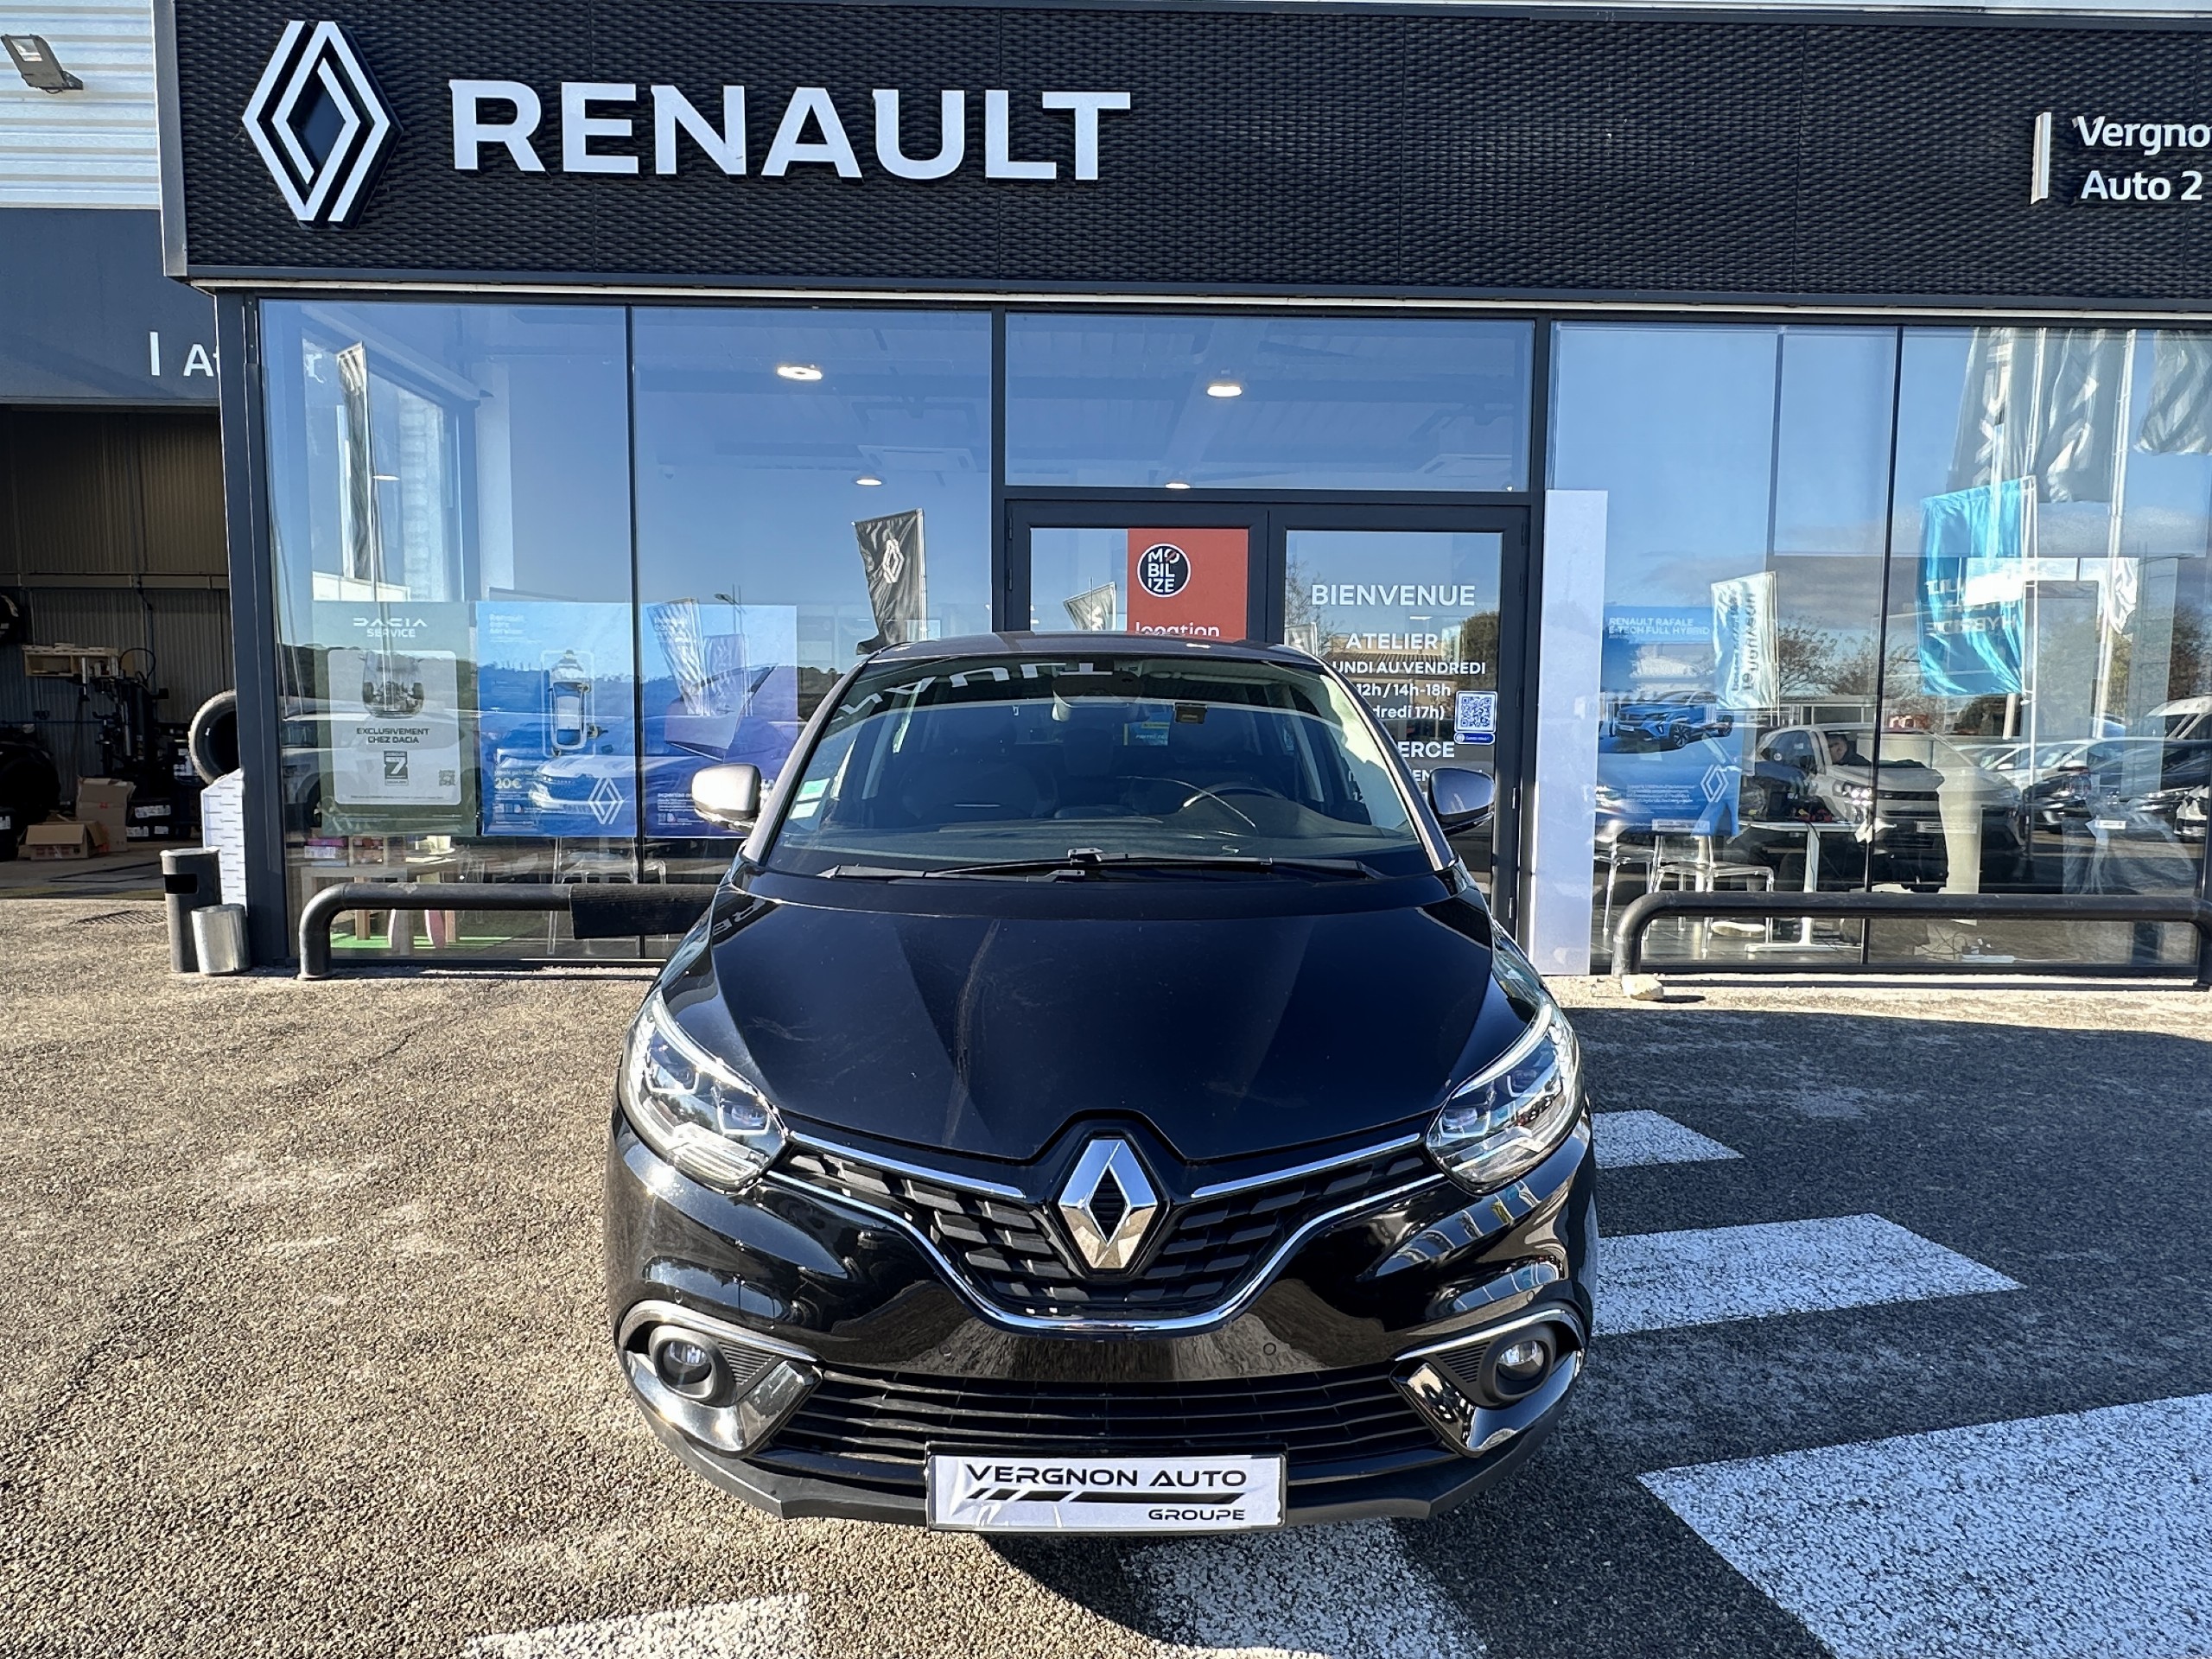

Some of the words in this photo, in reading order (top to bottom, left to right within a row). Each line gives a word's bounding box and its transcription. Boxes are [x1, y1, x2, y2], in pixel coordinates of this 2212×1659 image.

[448, 79, 1131, 181] RENAULT
[2073, 115, 2212, 156] Vergno
[2080, 170, 2171, 200] Auto
[2180, 170, 2202, 200] 2
[1147, 563, 1175, 578] BIL
[1147, 577, 1175, 593] IZE
[1311, 585, 1476, 606] BIENVENUE
[353, 617, 429, 627] DACIA
[1608, 617, 1654, 626] RENAULT
[1656, 618, 1694, 626] RAFALE
[366, 628, 416, 638] SERVICE
[1646, 626, 1670, 635] FULL
[1346, 633, 1438, 650] ATELIER
[1332, 661, 1373, 674] UNDI
[1376, 661, 1399, 674] AU
[1403, 661, 1485, 675] VENDREDI
[1373, 705, 1412, 718] dredi
[1414, 705, 1445, 720] 17h)
[1397, 741, 1455, 758] ERCE
[385, 756, 406, 774] 7
[494, 778, 522, 789] 20€
[963, 1463, 1139, 1487] VERGNON
[1149, 1470, 1247, 1487] AUTO
[1147, 1509, 1245, 1522] GROUPE
